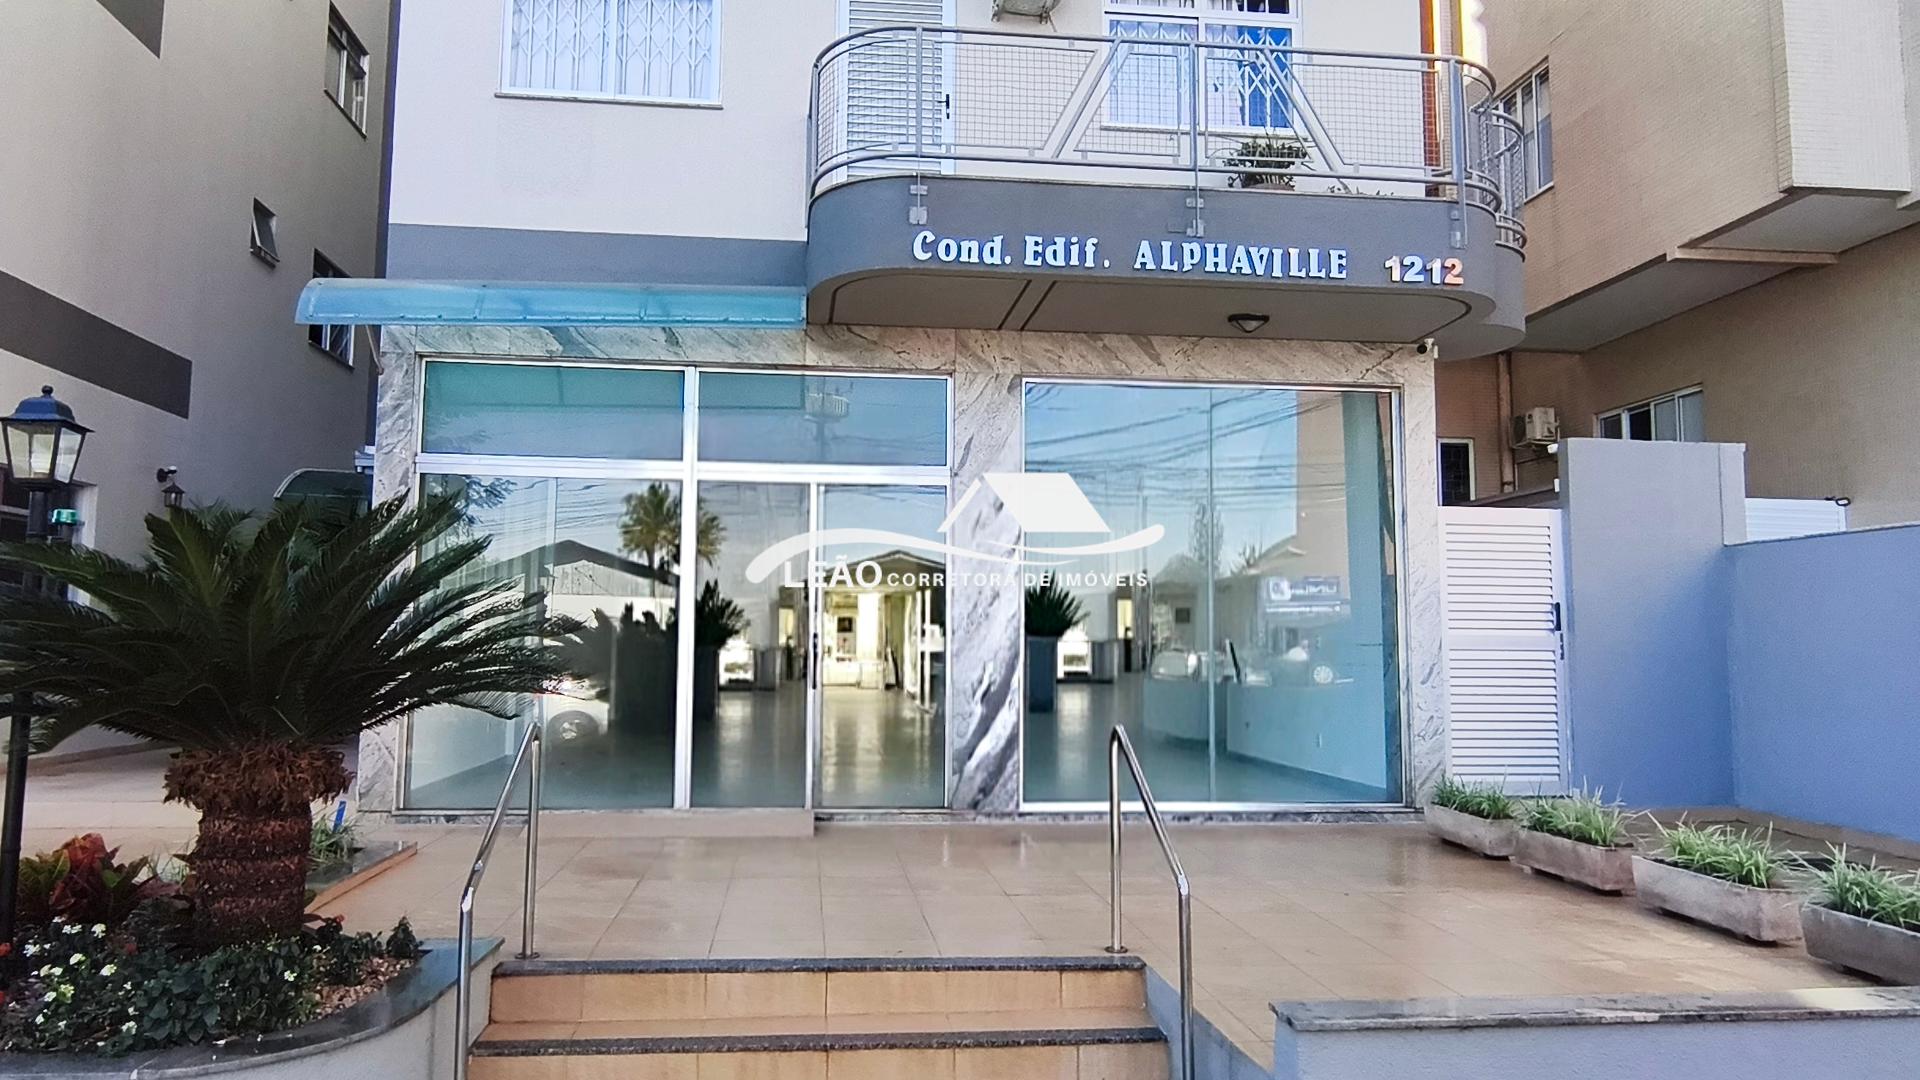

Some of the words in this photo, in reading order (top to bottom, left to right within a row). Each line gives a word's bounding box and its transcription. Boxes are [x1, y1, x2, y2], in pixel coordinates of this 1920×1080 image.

[912, 230, 1012, 265] Cond.
[1024, 235, 1110, 268] Edif.
[1133, 240, 1347, 279] ALPHAVILLE
[1384, 255, 1464, 285] 1212
